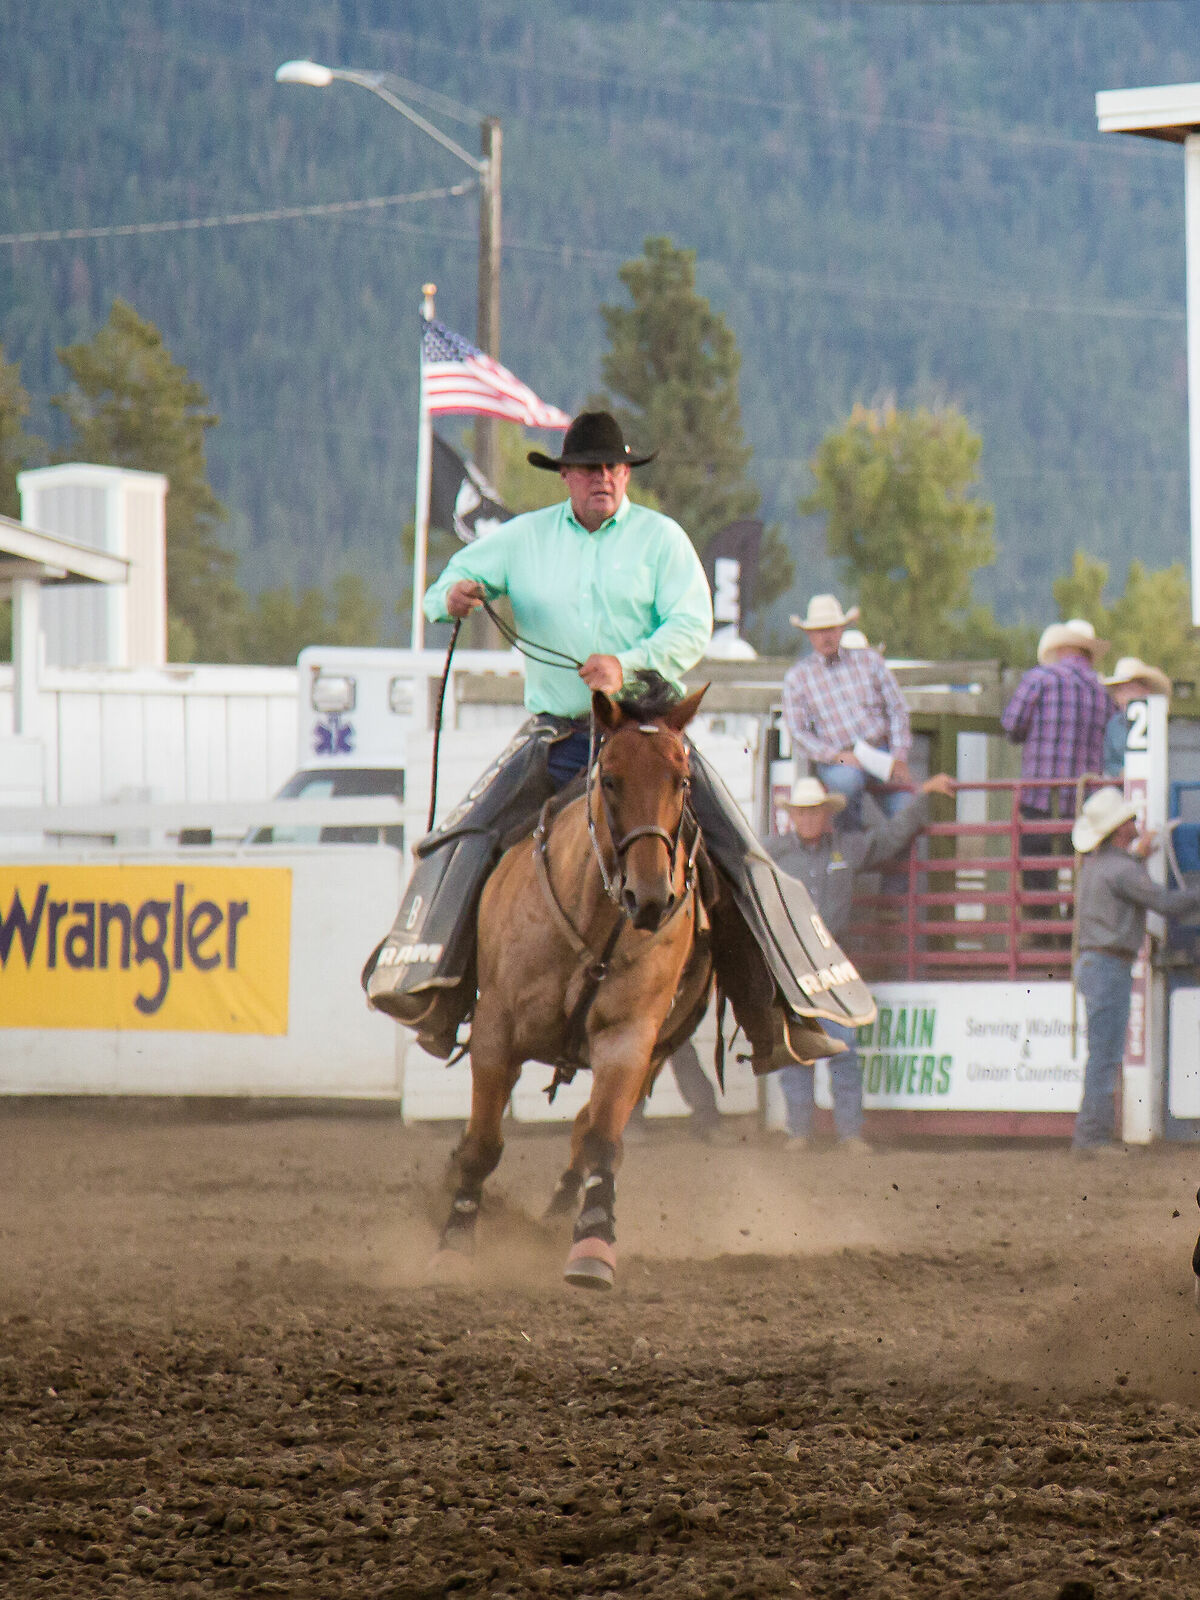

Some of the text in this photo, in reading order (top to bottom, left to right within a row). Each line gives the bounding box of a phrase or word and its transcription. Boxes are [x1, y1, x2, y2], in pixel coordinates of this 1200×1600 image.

[1126, 700, 1147, 750] 2
[0, 882, 249, 1015] Wrangler
[377, 943, 443, 966] RAM
[796, 961, 860, 995] RAM
[966, 1017, 1019, 1040] Serving
[967, 1064, 1011, 1083] Union
